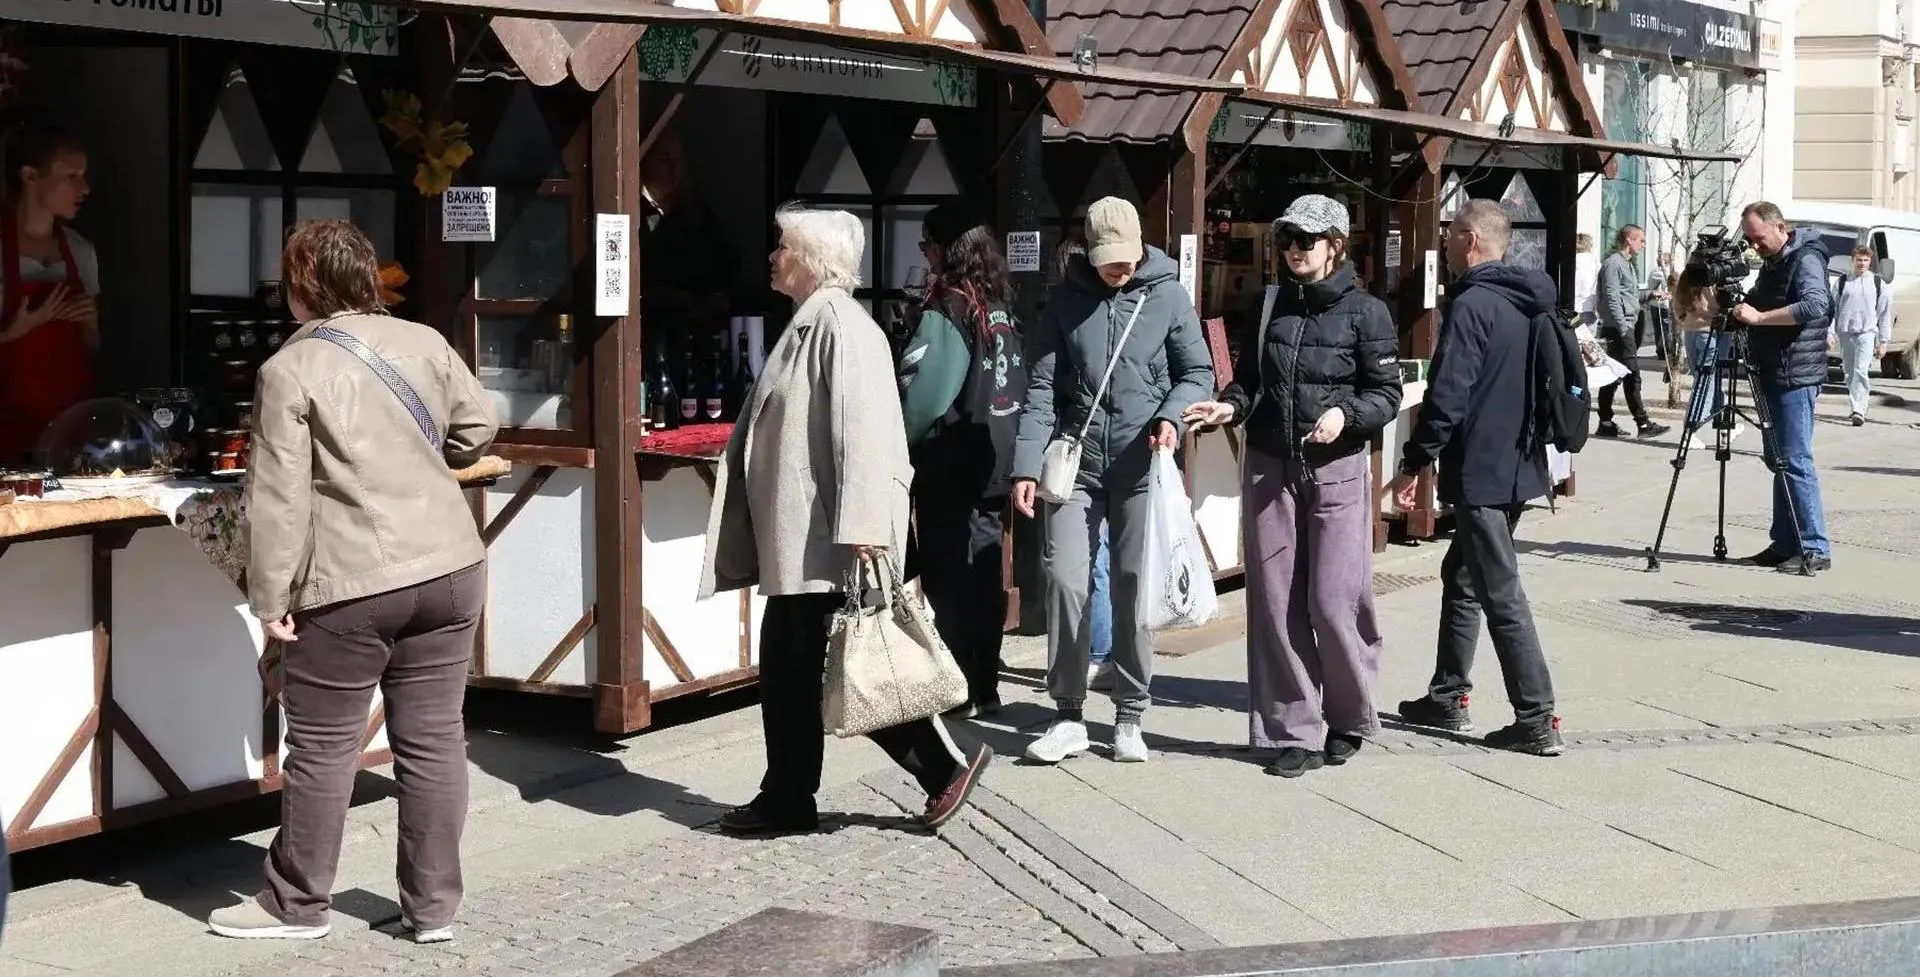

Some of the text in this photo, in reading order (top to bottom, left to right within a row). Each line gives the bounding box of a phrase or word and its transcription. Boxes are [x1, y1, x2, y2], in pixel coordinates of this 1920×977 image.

[93, 0, 222, 17] оматы
[771, 51, 883, 80] ФАНАГОРИЯ
[447, 190, 491, 204] ВАЖНО!
